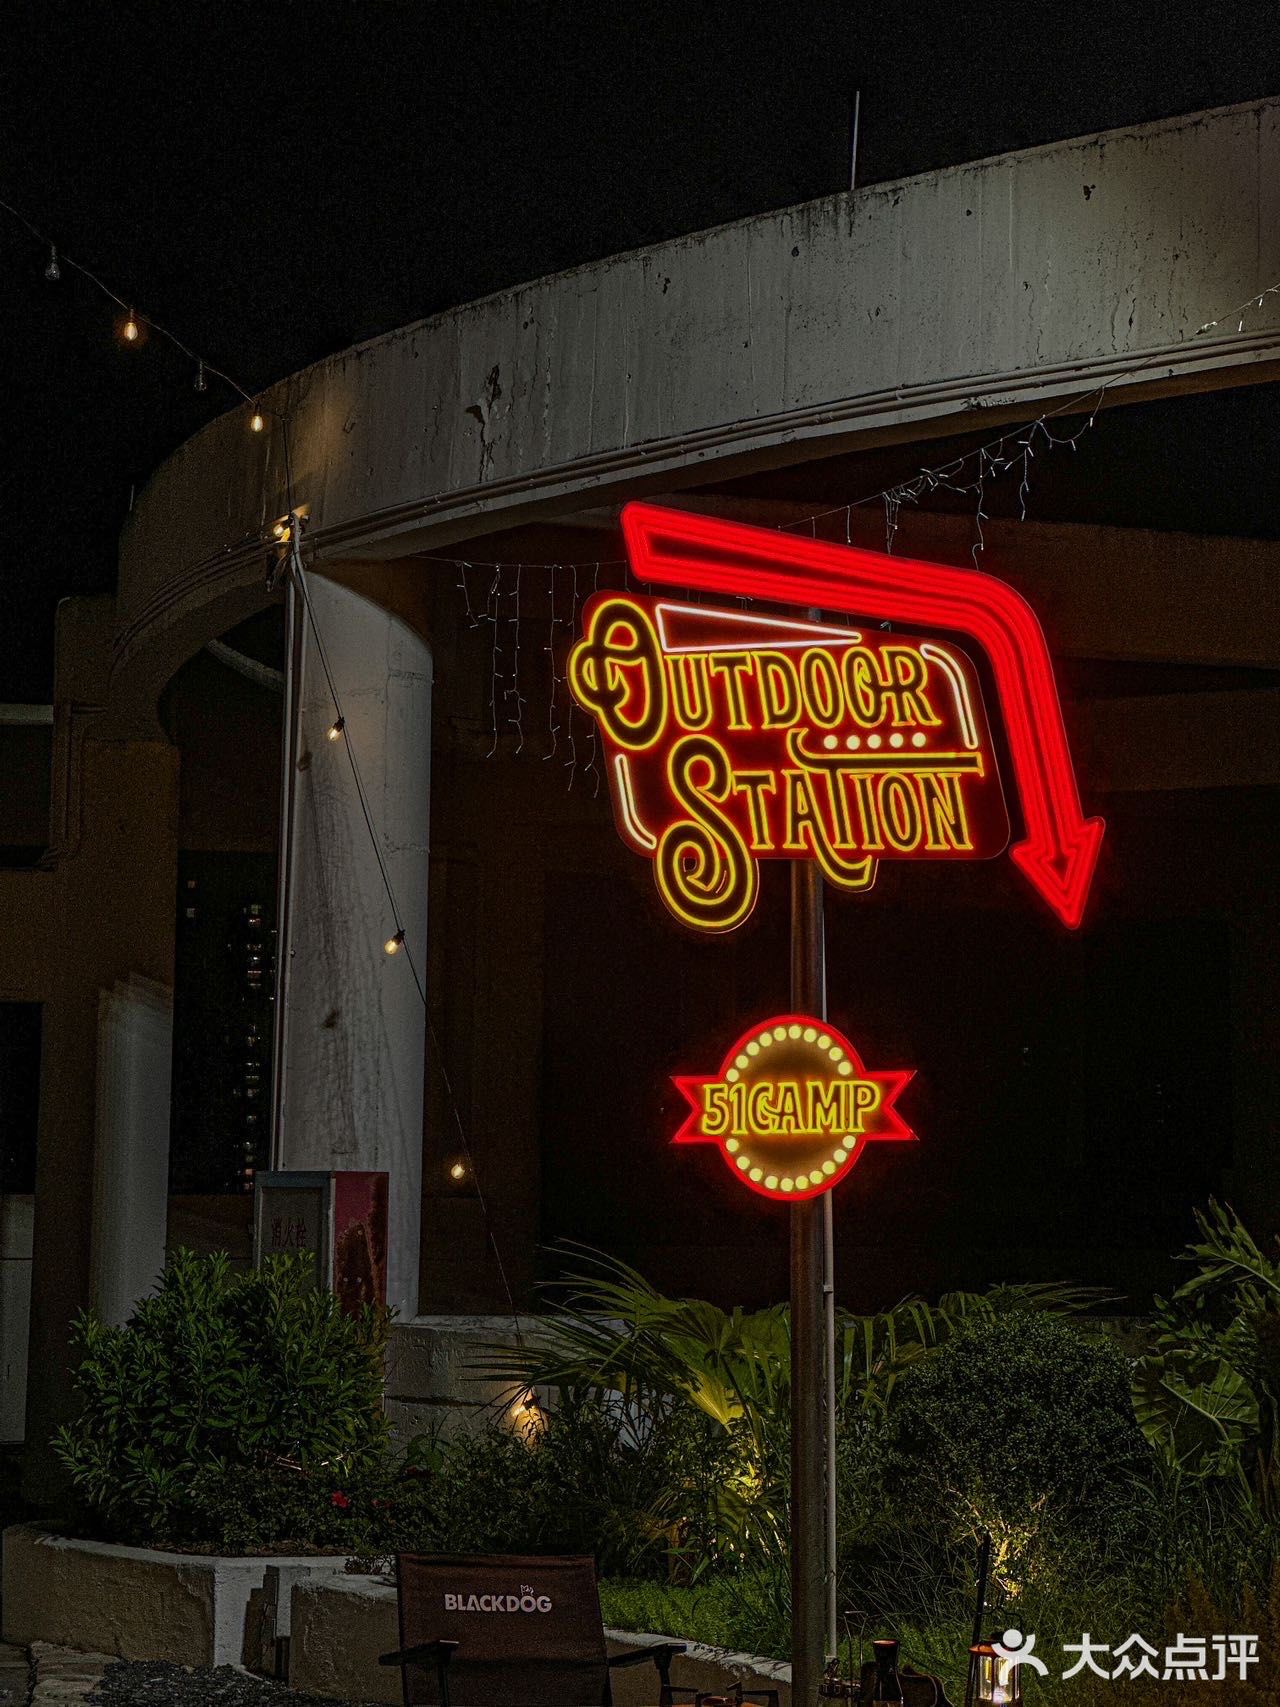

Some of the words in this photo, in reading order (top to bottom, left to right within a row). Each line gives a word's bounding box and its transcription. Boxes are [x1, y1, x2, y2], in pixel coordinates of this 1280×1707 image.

[568, 599, 942, 750] OUTDOOR
[655, 729, 984, 927] STATION
[702, 1081, 881, 1135] 51CAMP
[444, 1594, 553, 1613] BLACKDOG
